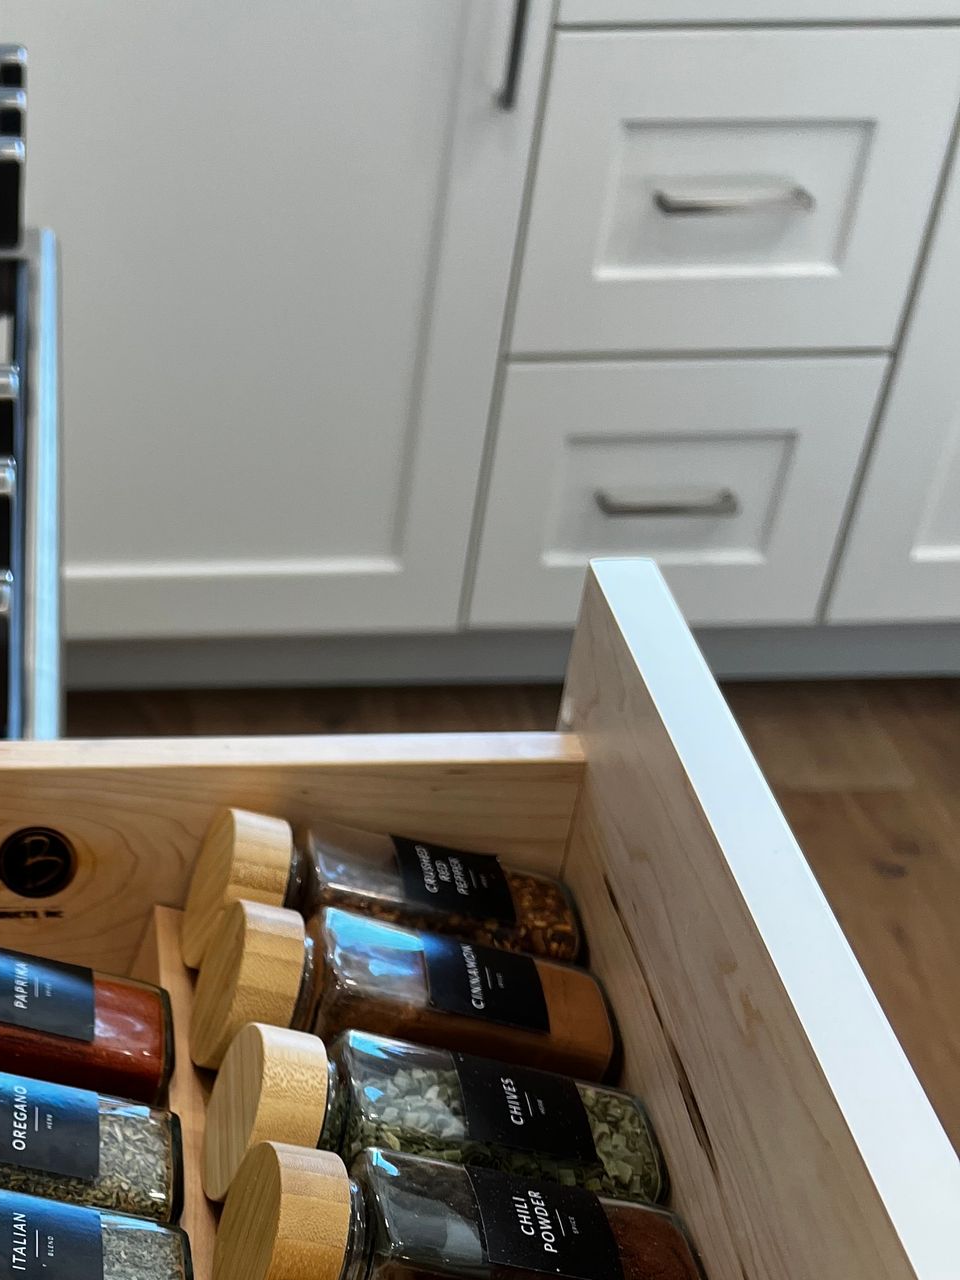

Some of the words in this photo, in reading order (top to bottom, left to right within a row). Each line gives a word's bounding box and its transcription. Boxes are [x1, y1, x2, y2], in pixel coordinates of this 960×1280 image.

[414, 844, 439, 894] CRUSHED
[434, 860, 451, 883] RED
[448, 857, 469, 896] PEPPER
[13, 962, 28, 1010] PAPRIKA
[461, 945, 485, 1010] CINNAMON
[12, 1085, 28, 1152] OREGANO
[500, 1077, 524, 1126] CHIVES
[512, 1196, 535, 1236] CHILI
[527, 1190, 558, 1254] POWDER
[568, 1215, 580, 1235] SPICE
[12, 1212, 27, 1271] ITALIAN
